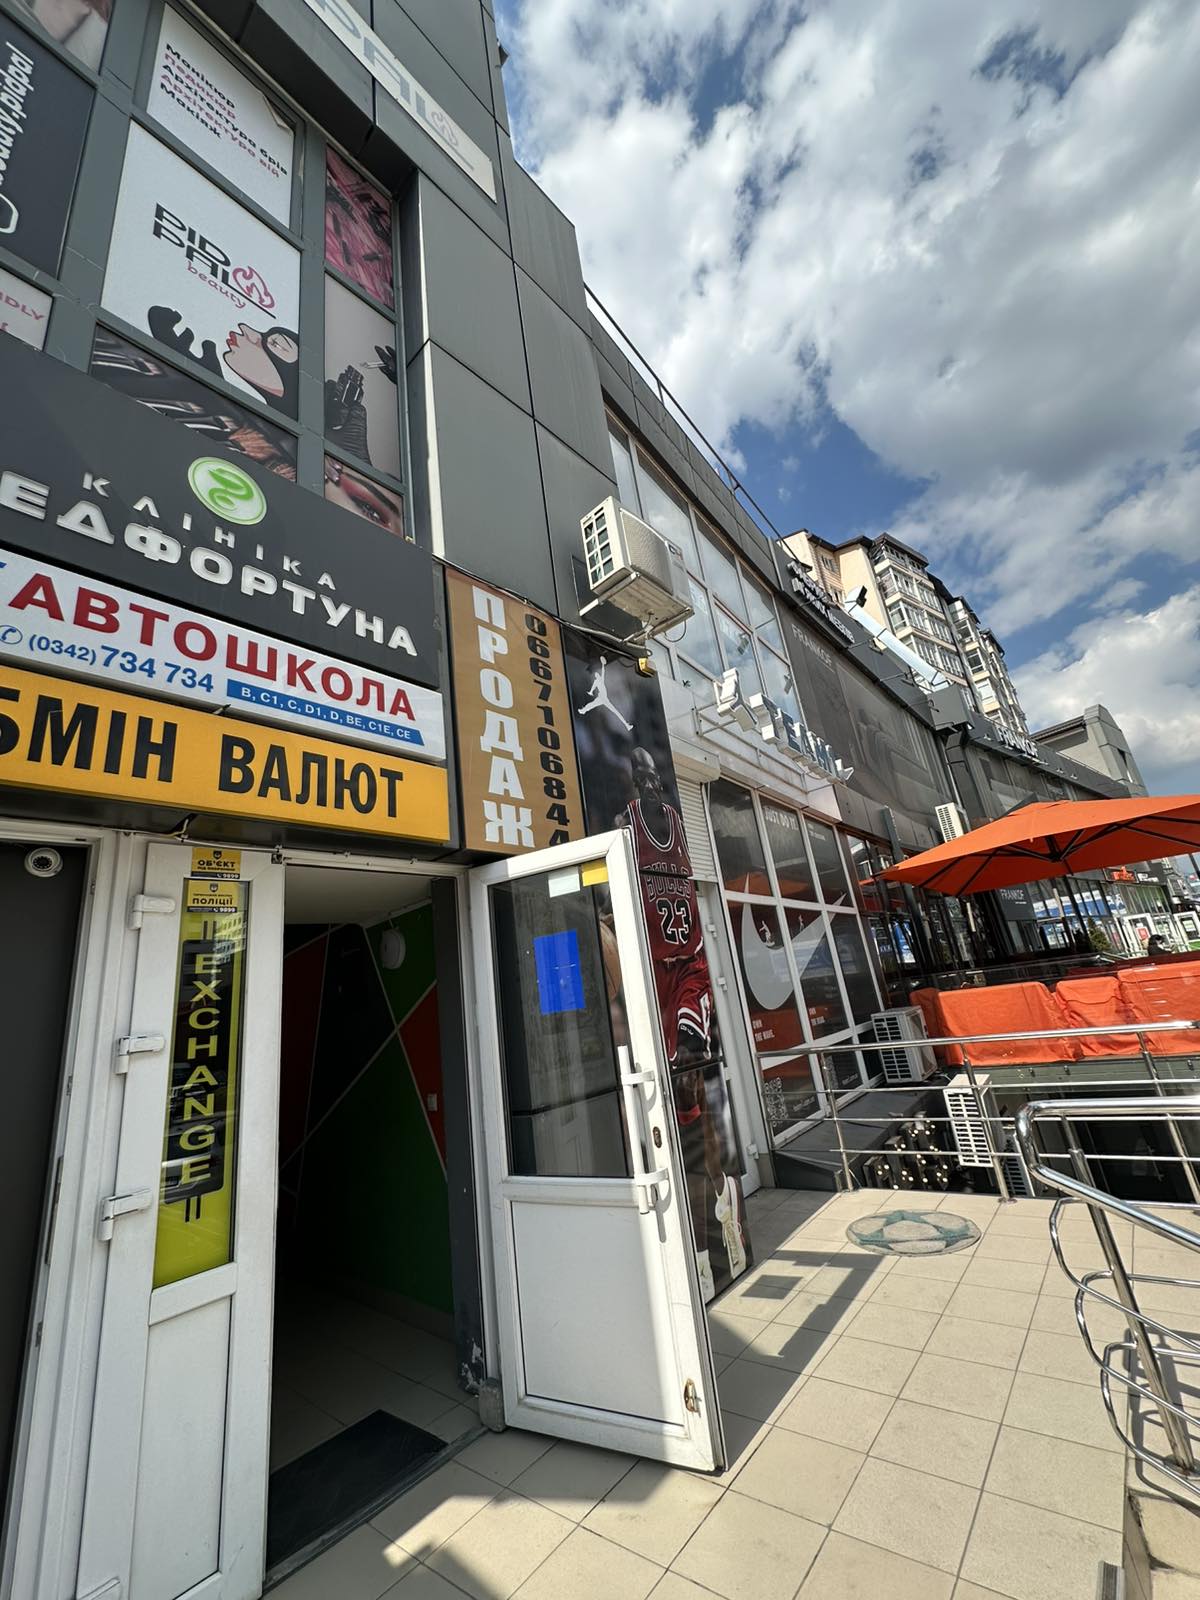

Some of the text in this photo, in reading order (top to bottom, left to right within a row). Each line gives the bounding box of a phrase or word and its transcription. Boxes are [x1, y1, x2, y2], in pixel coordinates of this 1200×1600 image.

[164, 53, 236, 119] Педикюр
[166, 43, 235, 109] Манікюр
[160, 82, 222, 139] Макіяж
[161, 74, 256, 157] Архітектура
[163, 64, 288, 175] Архітектура брів
[187, 260, 247, 308] beauty
[8, 572, 417, 722] АВТОШКОЛА
[29, 634, 214, 693] (0342) 734 734
[241, 687, 411, 740] B, C1, C, D1, D, BE, C1E, CE
[472, 585, 535, 848] ПРОДАЖ
[218, 734, 404, 819] ВАЛЮТ
[192, 897, 233, 905] ПОЛІЦІЇ
[656, 898, 692, 945] 23
[178, 954, 222, 1185] EXCHANGE
